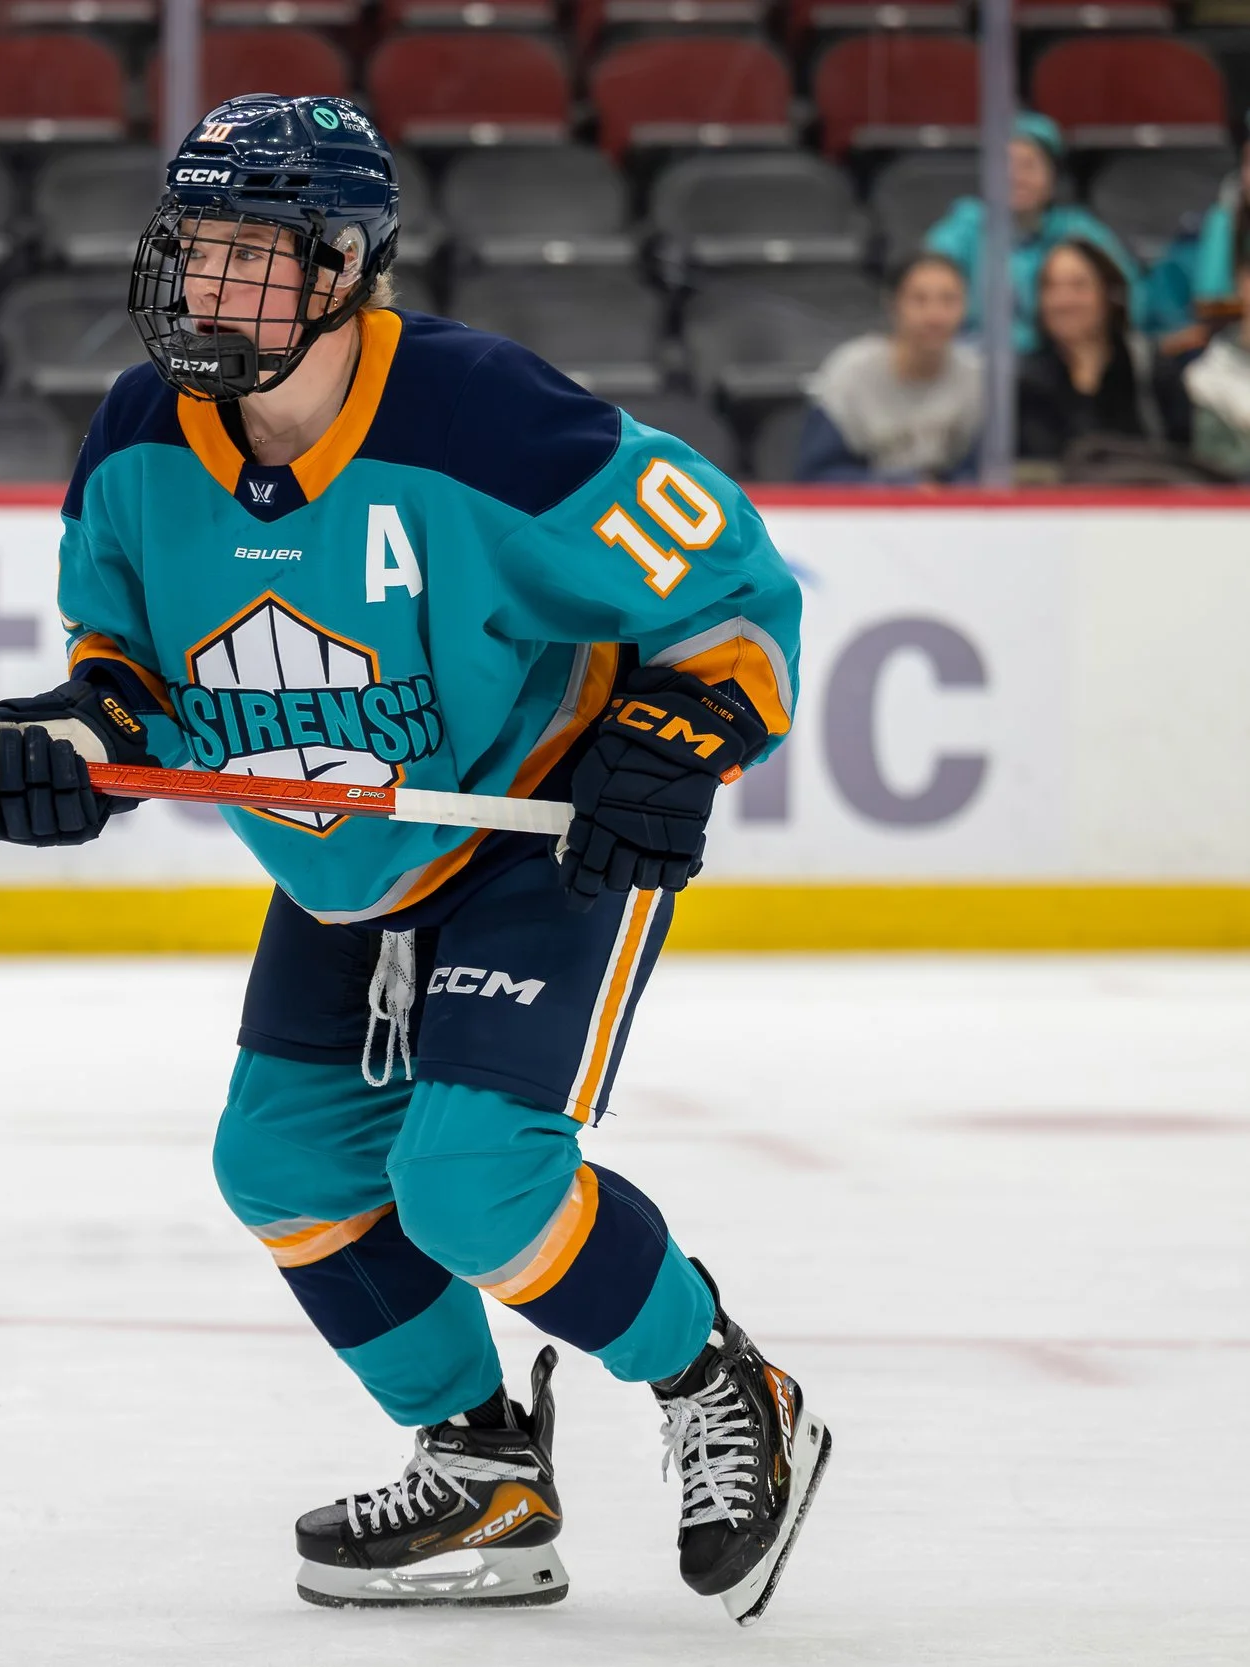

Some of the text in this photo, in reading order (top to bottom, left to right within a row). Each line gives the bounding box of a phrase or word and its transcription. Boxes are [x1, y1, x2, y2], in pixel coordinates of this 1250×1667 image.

[197, 123, 233, 142] 10
[176, 169, 231, 184] CCM
[171, 358, 218, 372] CCM
[592, 458, 727, 600] 10
[234, 547, 303, 561] BAUER
[366, 504, 423, 603] A
[104, 698, 141, 732] CCM
[701, 696, 734, 722] FILLIER
[179, 685, 412, 768] SIRENS
[347, 788, 362, 799] 8
[362, 791, 386, 799] PRO
[427, 966, 546, 1006] CCM
[463, 1499, 529, 1546] CCM
